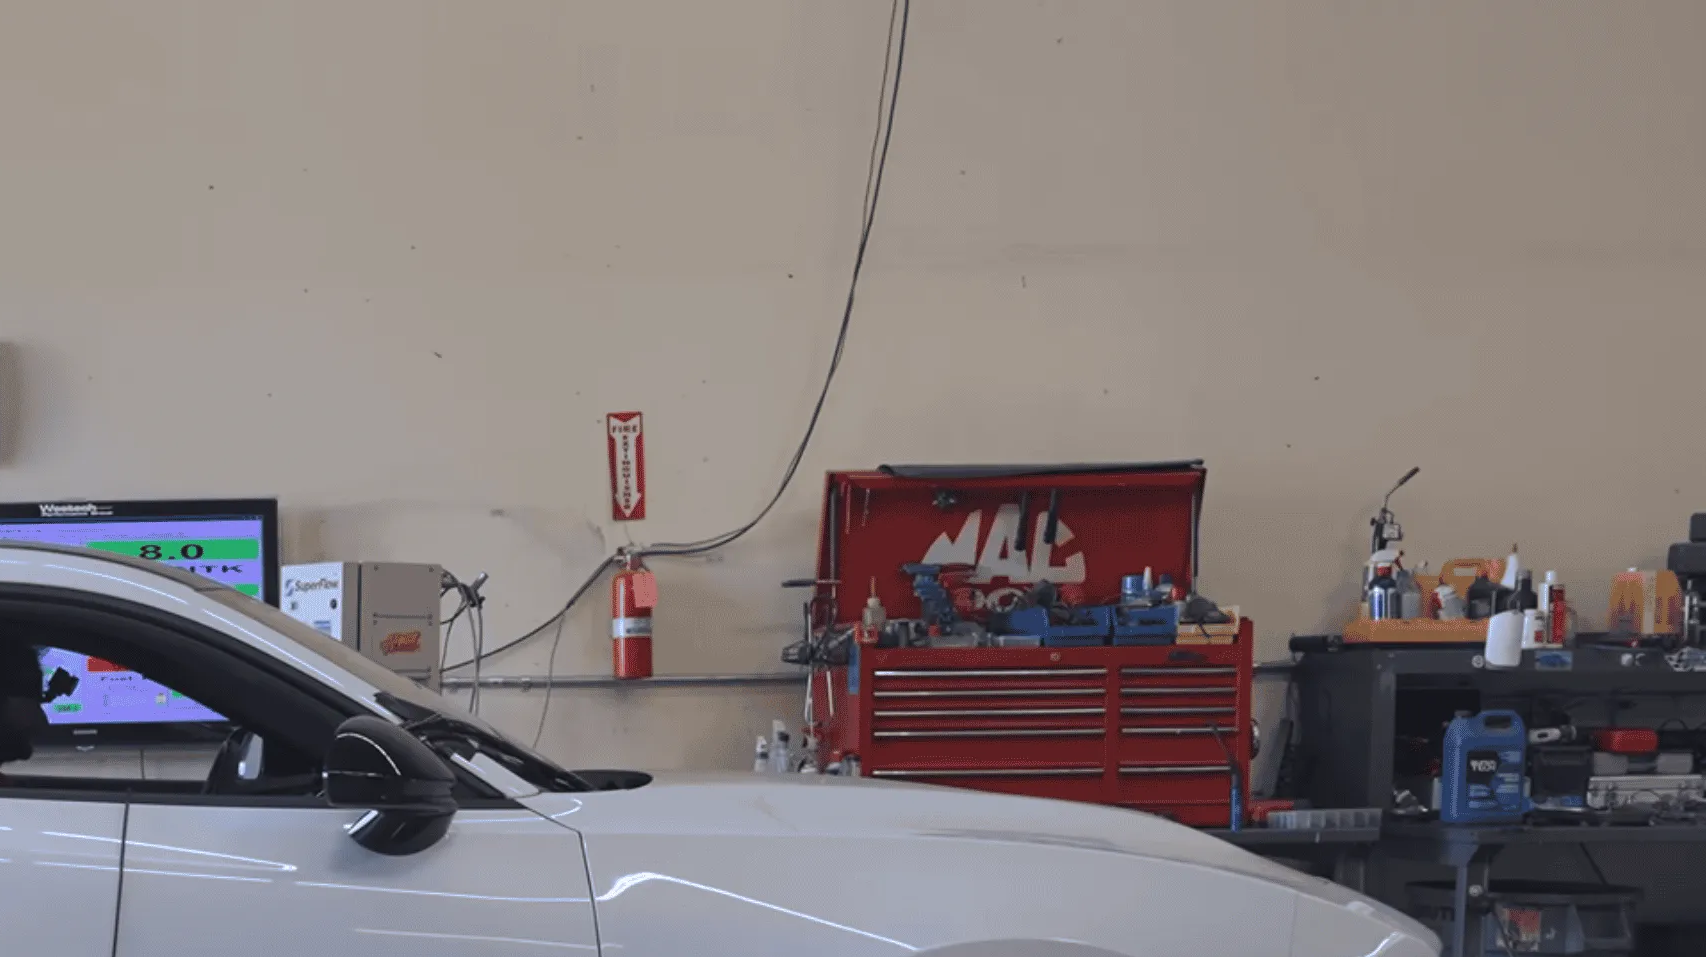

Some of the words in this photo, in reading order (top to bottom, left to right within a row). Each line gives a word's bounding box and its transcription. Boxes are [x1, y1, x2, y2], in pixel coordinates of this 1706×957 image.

[612, 424, 637, 433] FIRE
[139, 543, 205, 560] 8.0
[922, 503, 1086, 584] MAC
